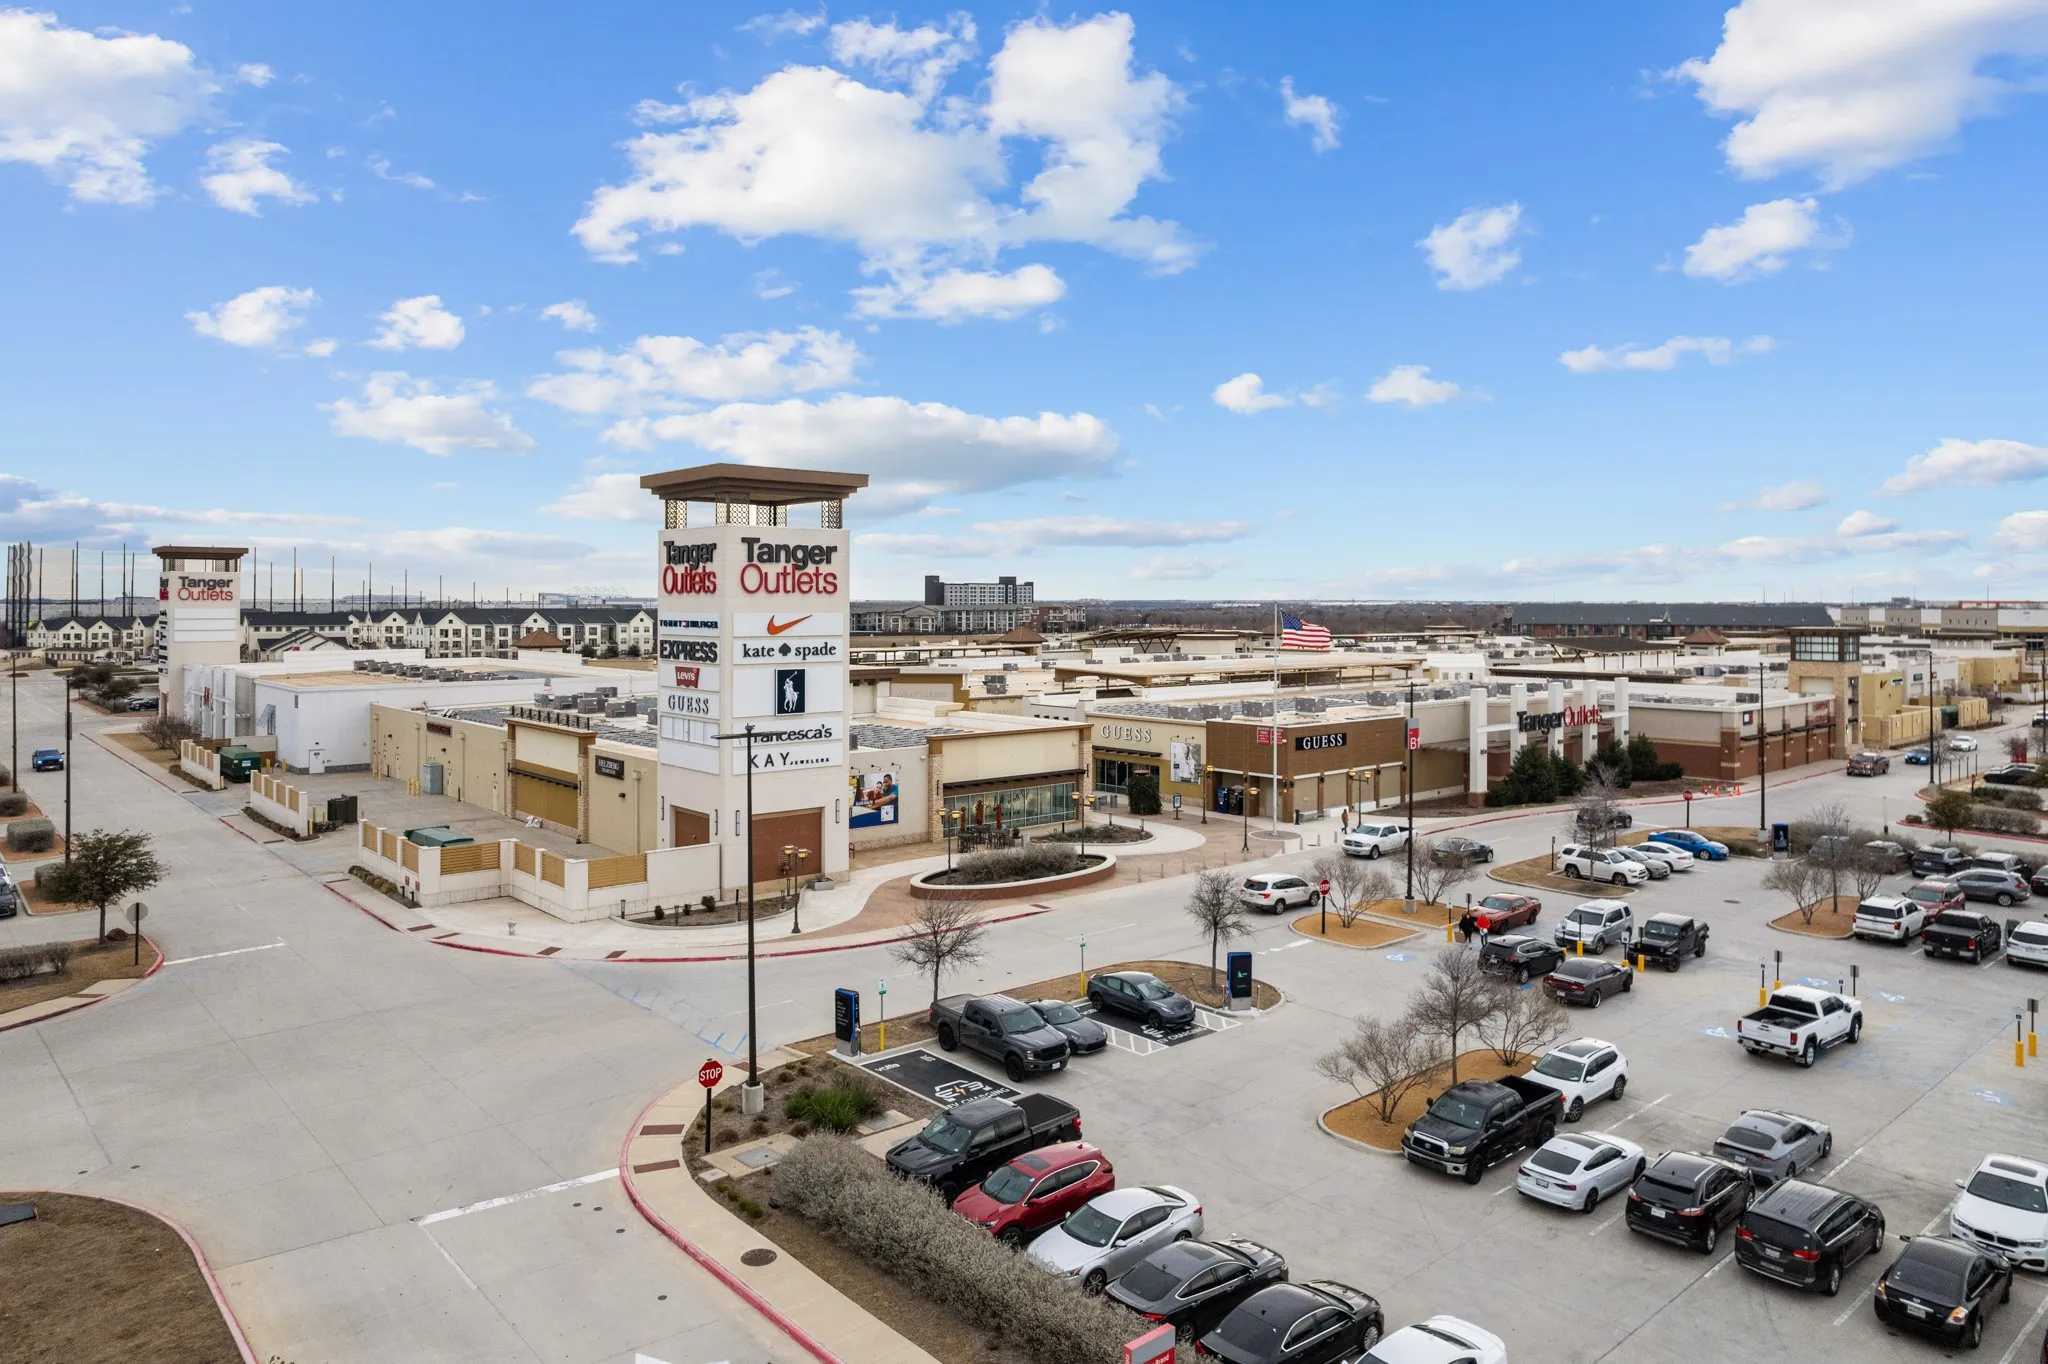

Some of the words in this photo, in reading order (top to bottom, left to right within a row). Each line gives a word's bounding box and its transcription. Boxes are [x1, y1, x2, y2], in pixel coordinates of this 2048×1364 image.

[663, 540, 717, 570] Tanger
[741, 537, 838, 570] Tanger
[179, 576, 234, 590] Tanger
[663, 564, 717, 594] Outlets
[740, 563, 838, 594] Outlets
[178, 587, 234, 601] Outlets
[660, 639, 718, 663] EXPRESS
[742, 643, 775, 658] kate
[794, 641, 837, 661] spade
[668, 694, 709, 715] GUESS
[752, 724, 833, 744] rancesca's
[1100, 724, 1152, 743] GUESS
[1303, 733, 1343, 750] GUESS
[699, 1067, 722, 1082] STOP
